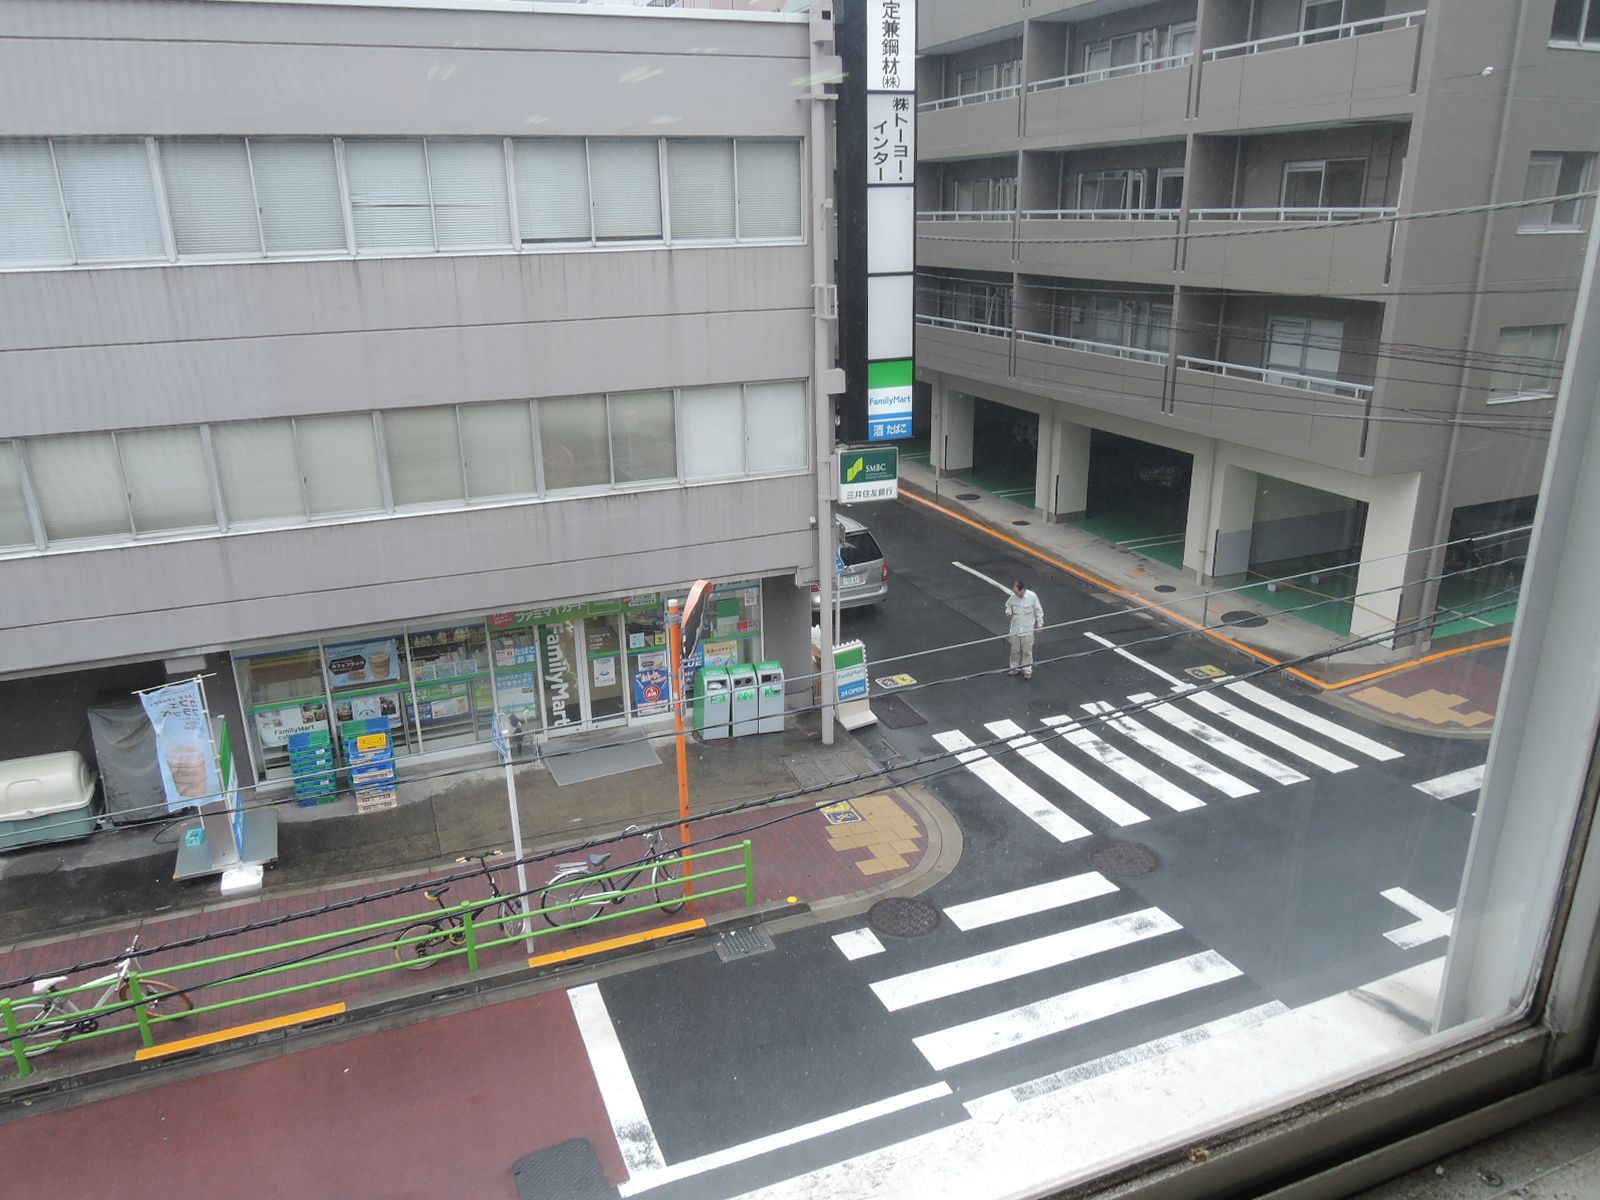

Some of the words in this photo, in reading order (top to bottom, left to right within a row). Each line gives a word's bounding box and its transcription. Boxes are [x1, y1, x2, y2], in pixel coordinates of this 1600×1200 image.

[873, 120, 889, 182] インター
[869, 394, 911, 407] FamilyMart
[873, 424, 884, 437] 酒
[886, 423, 907, 435] たばこ
[865, 463, 886, 473] SMBC
[847, 487, 893, 499] 三井住友銀行
[544, 622, 571, 727] FamilyMart
[274, 724, 315, 736] FamilyMart
